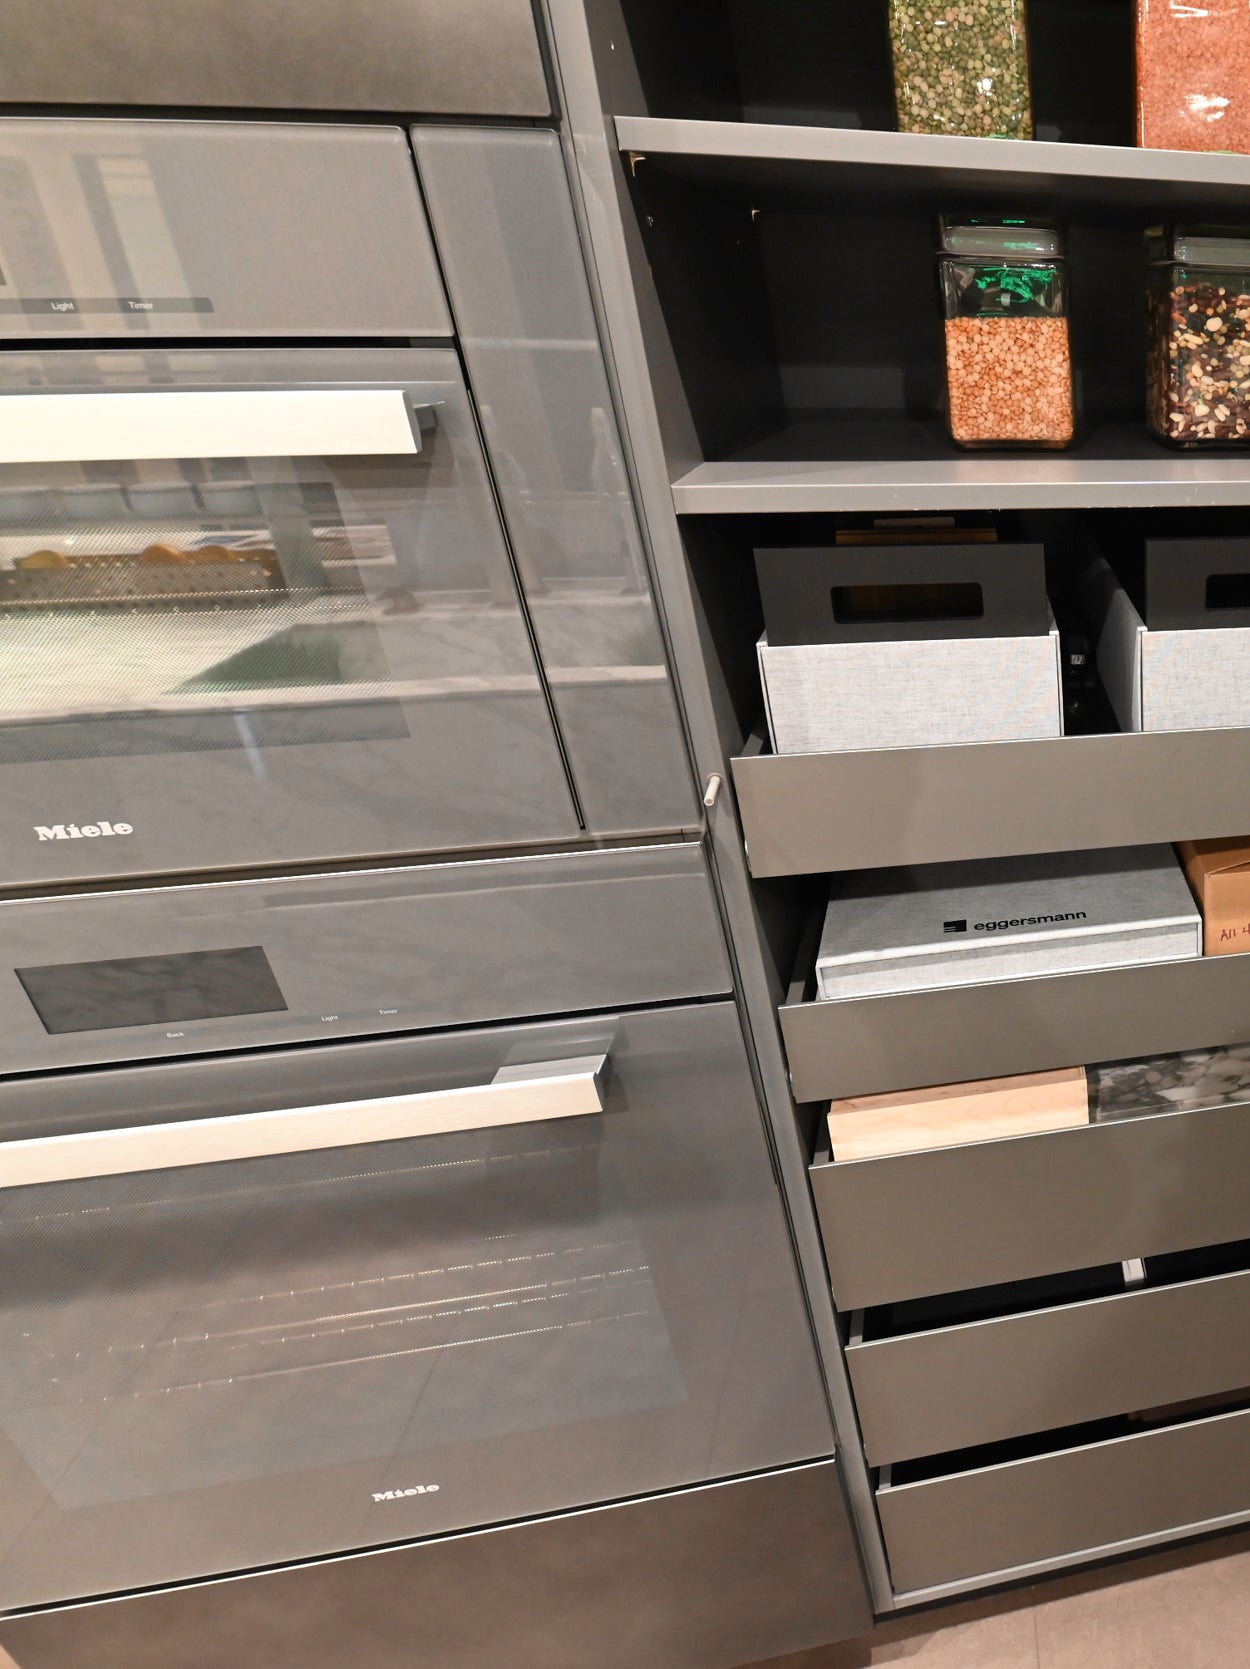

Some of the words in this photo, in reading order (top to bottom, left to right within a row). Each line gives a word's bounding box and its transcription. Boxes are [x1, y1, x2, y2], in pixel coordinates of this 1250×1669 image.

[51, 302, 75, 312] Light
[128, 301, 154, 310] Timer
[34, 821, 134, 841] Miele
[973, 911, 1087, 932] eggersmann
[371, 1484, 441, 1502] Miele
